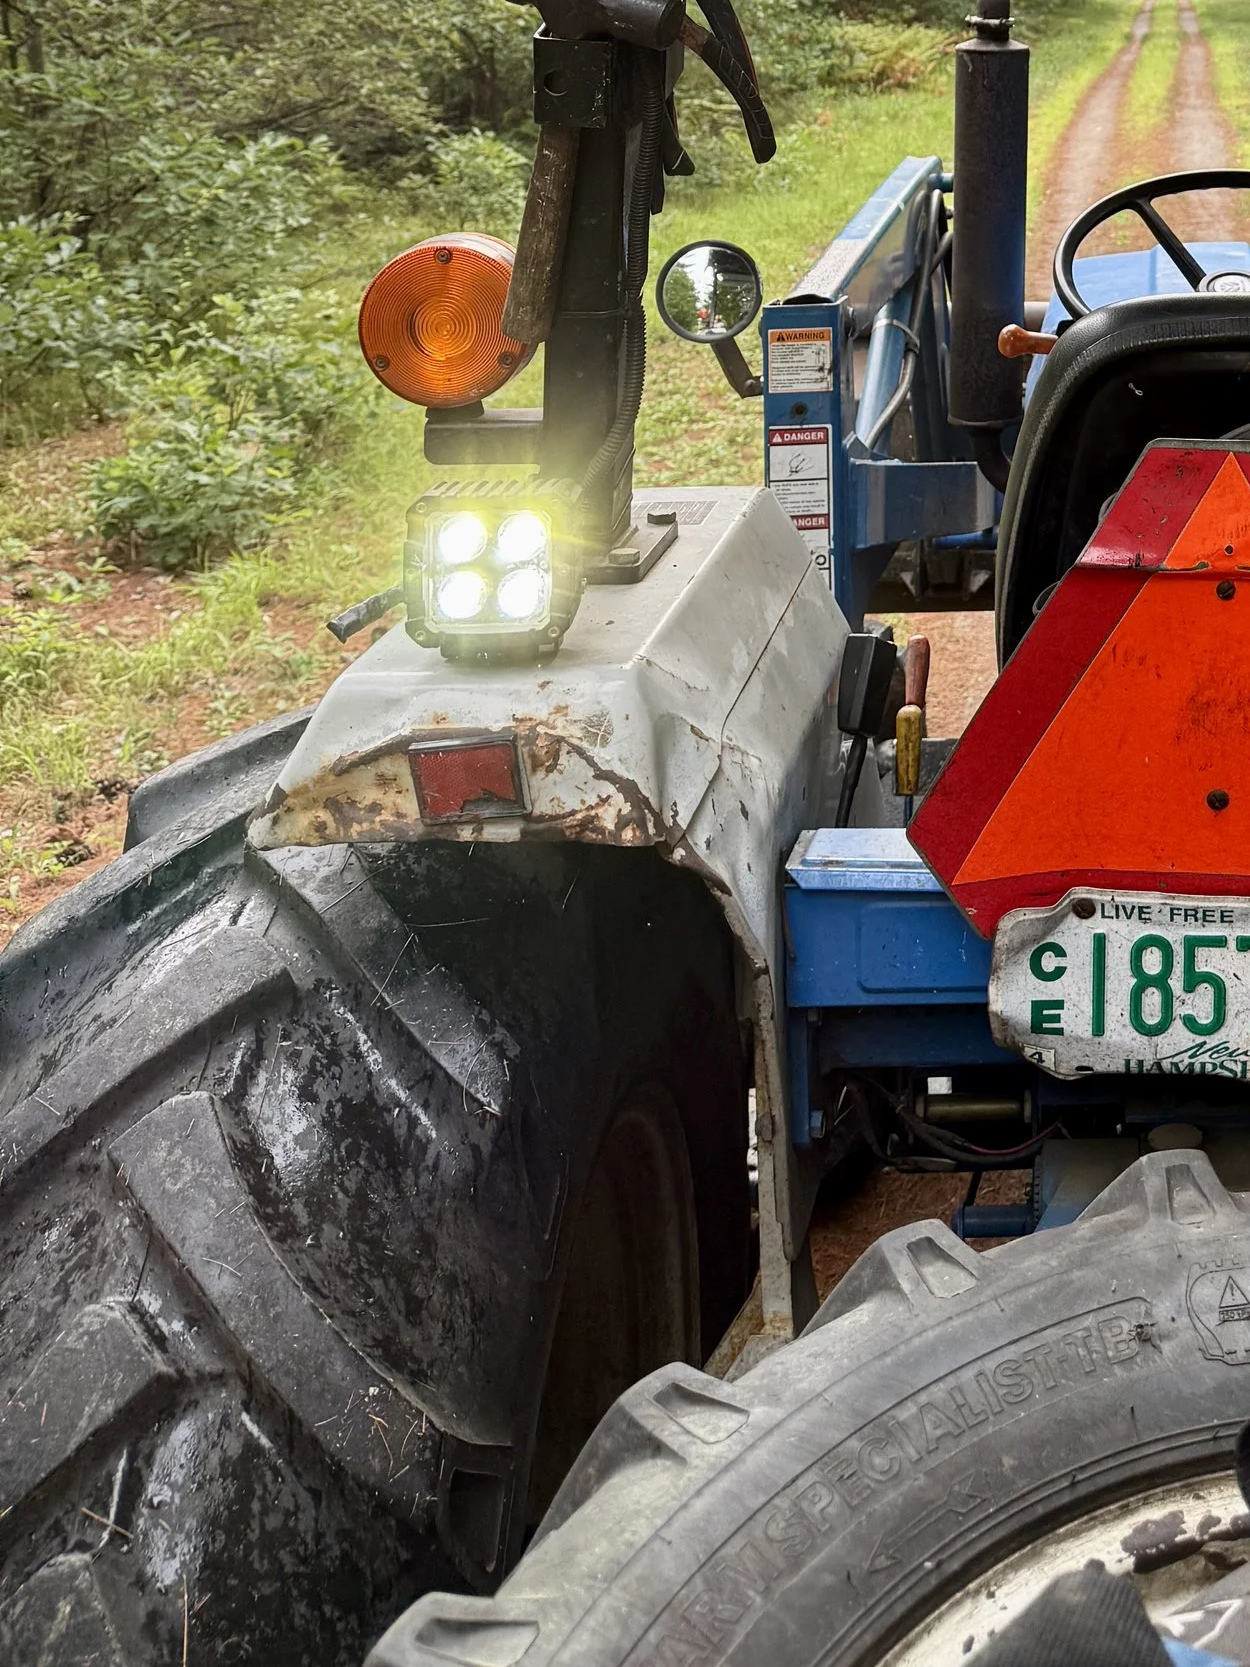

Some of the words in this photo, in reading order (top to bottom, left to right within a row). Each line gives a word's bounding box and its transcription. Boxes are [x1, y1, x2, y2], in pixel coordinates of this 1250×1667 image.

[785, 331, 825, 342] WARNING
[783, 431, 825, 443] DANGER
[793, 517, 826, 529] ANGER
[1100, 902, 1152, 922] LIVE
[1169, 906, 1235, 925] FREE
[1029, 1051, 1046, 1064] 4
[645, 1540, 781, 1667] ARM
